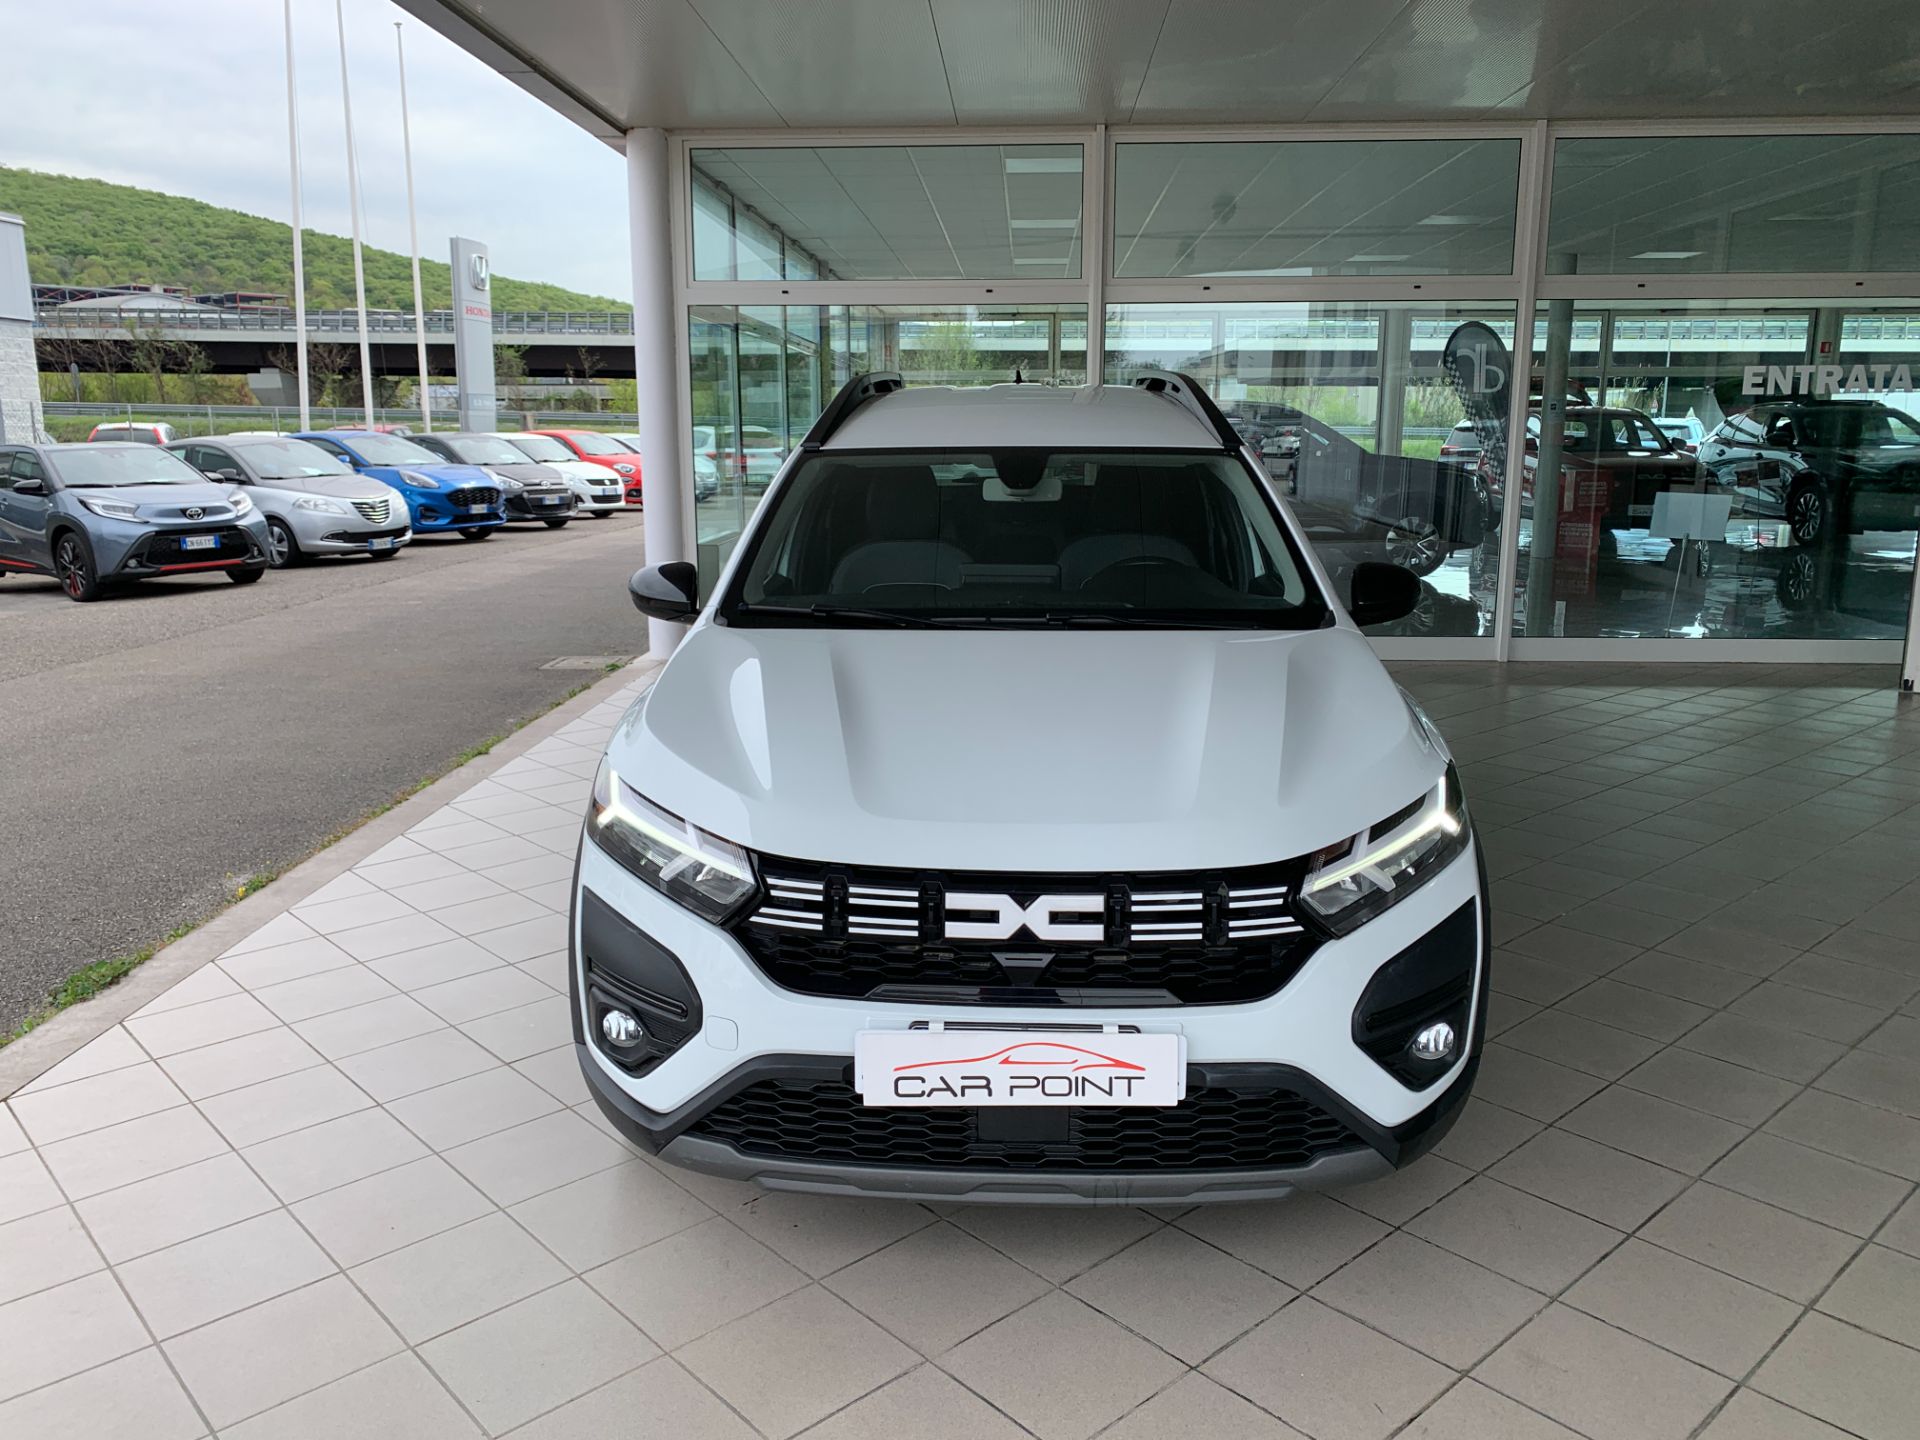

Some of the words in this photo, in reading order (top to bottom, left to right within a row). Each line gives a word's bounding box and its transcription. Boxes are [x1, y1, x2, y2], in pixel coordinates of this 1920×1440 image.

[1742, 364, 1913, 396] ENTRATA
[893, 1075, 993, 1098] CAR
[1009, 1075, 1146, 1098] POINT
